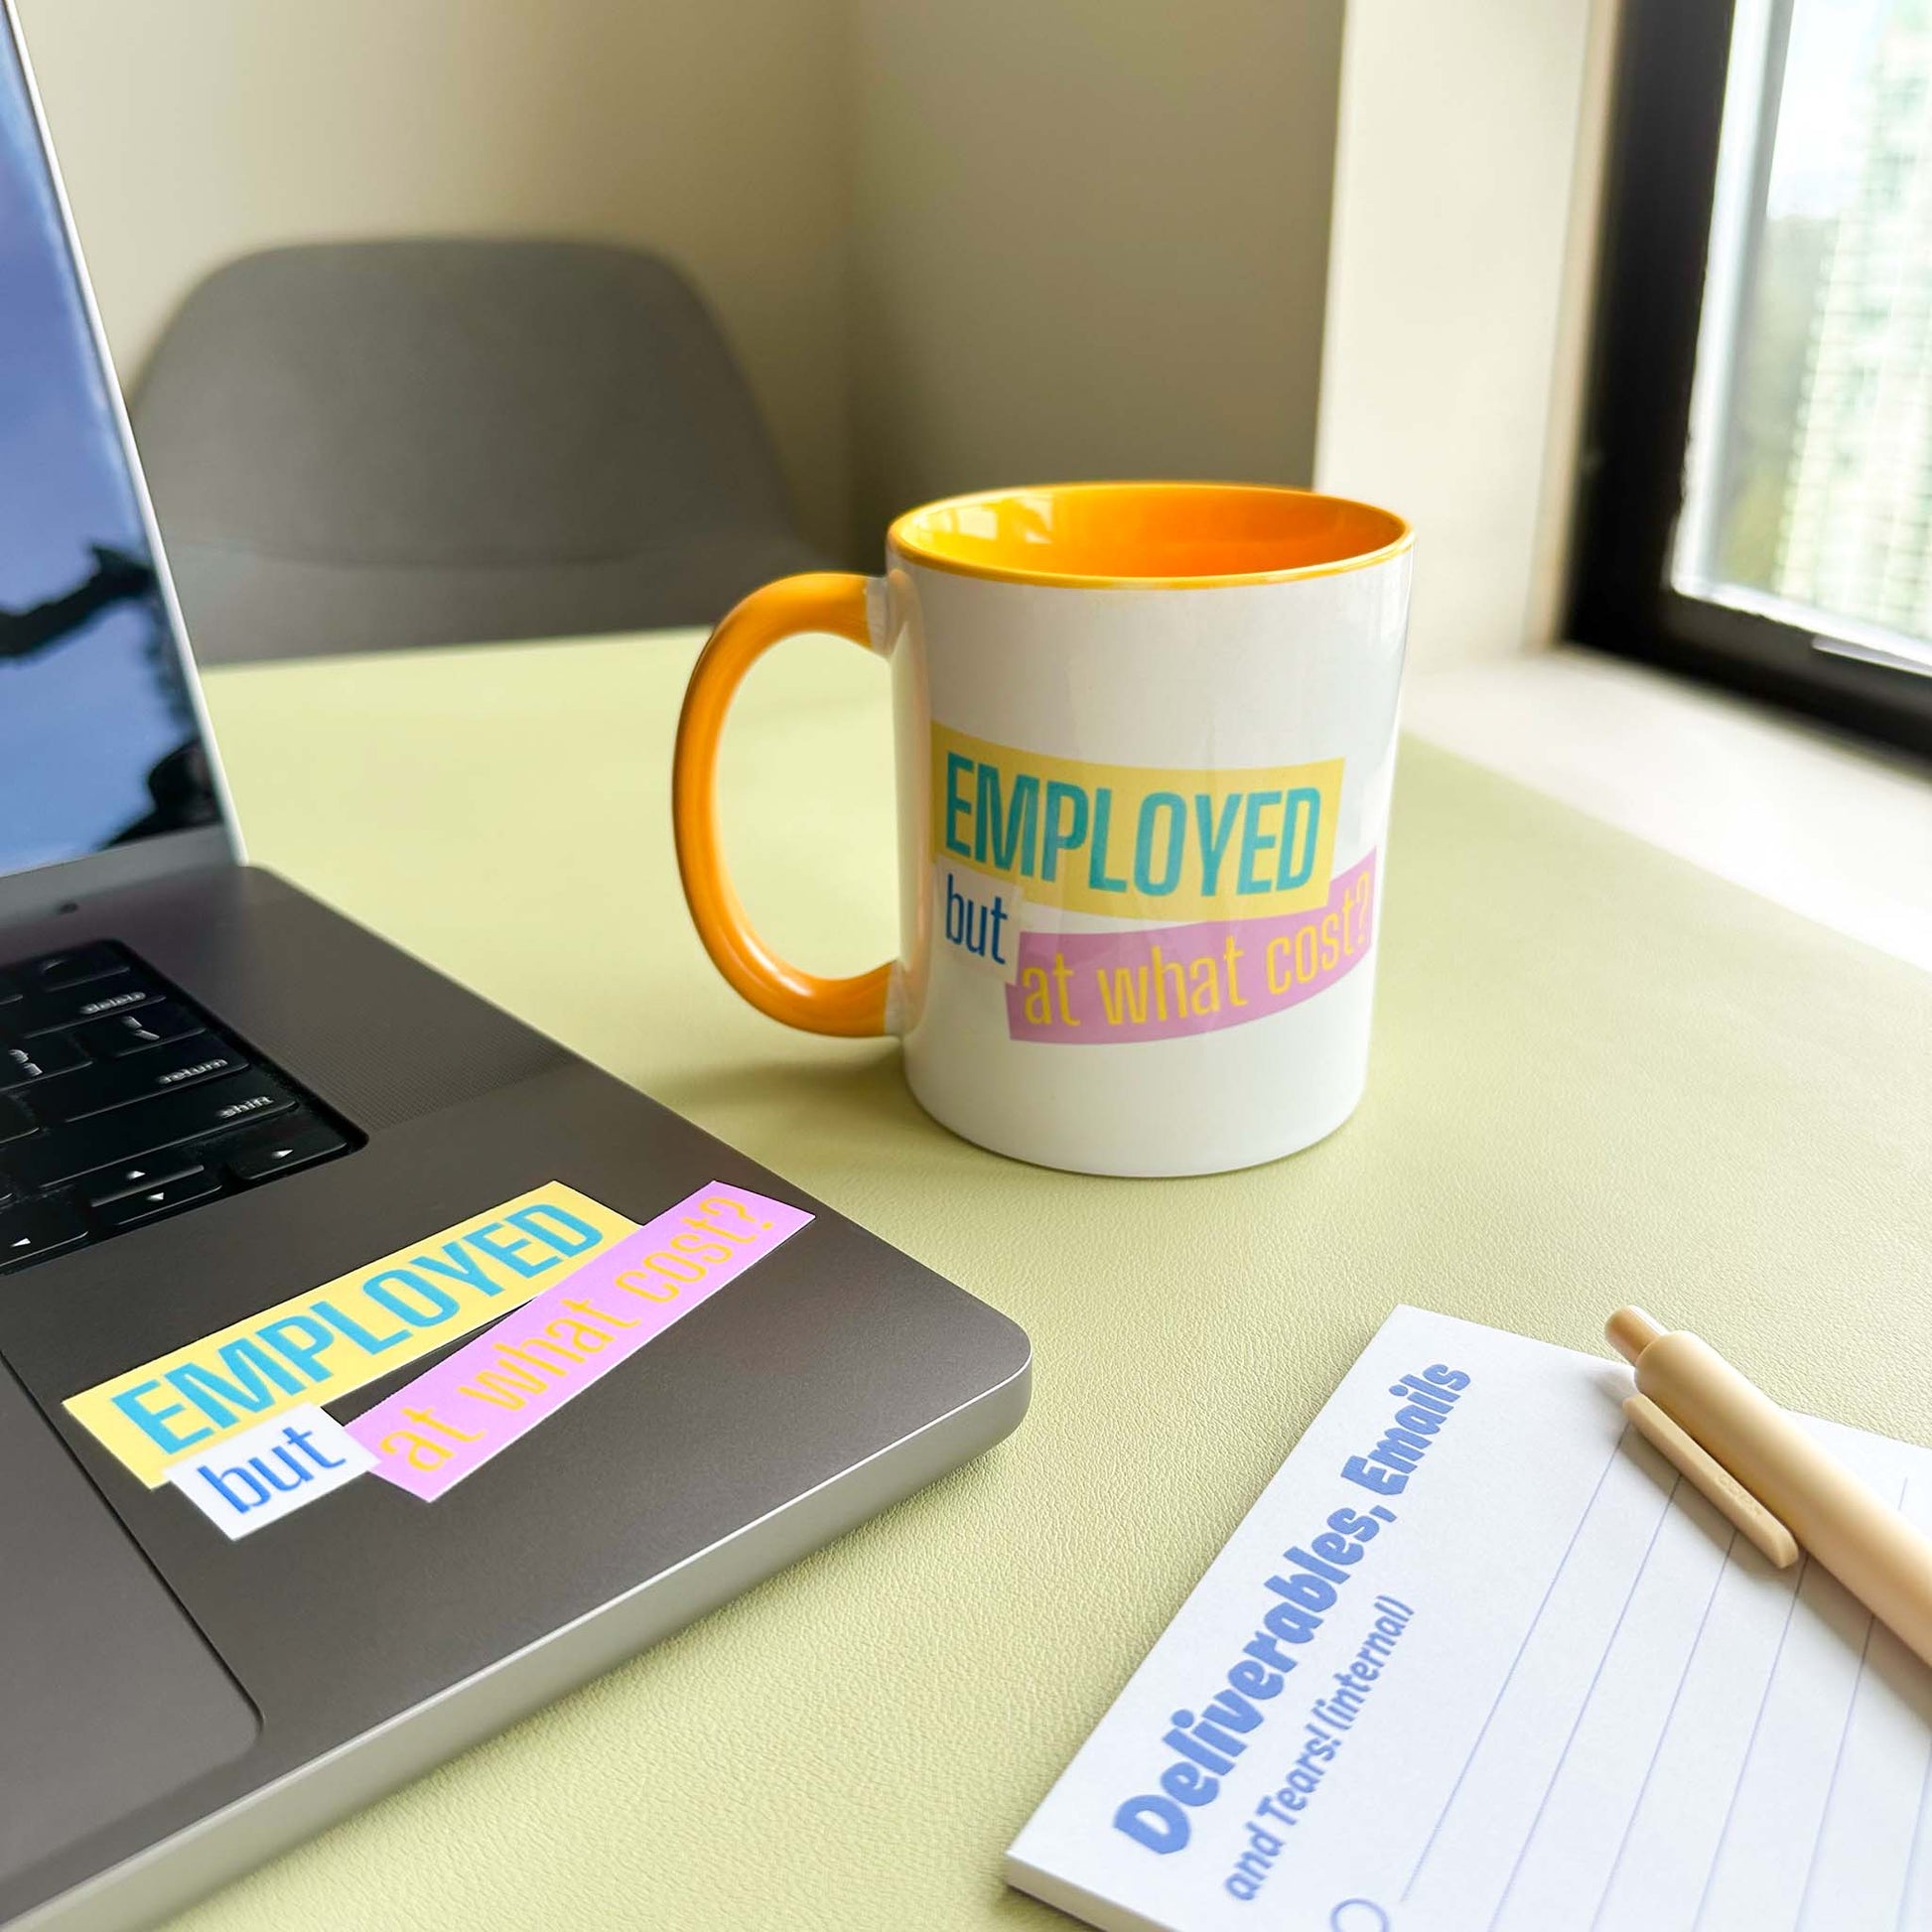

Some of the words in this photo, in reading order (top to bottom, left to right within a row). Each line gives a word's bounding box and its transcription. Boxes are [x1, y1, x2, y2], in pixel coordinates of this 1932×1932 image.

[946, 751, 1321, 897] EMPLOYED
[946, 874, 1008, 964] but
[1022, 952, 1080, 1027] at
[1097, 935, 1248, 1027] what
[1265, 871, 1372, 996] cost?
[158, 1058, 228, 1084] return
[218, 1095, 273, 1119] shift
[111, 1202, 604, 1453] EMPLOYED
[379, 1406, 484, 1473] at
[458, 1297, 640, 1413] what
[615, 1198, 775, 1305] cost?
[197, 1427, 345, 1515] but
[1113, 1503, 1398, 1856] Deliverables,
[1340, 1363, 1471, 1496] Emails
[1223, 1825, 1285, 1902] and
[1256, 1722, 1339, 1833] Tears!
[1311, 1594, 1415, 1732] (internal)
